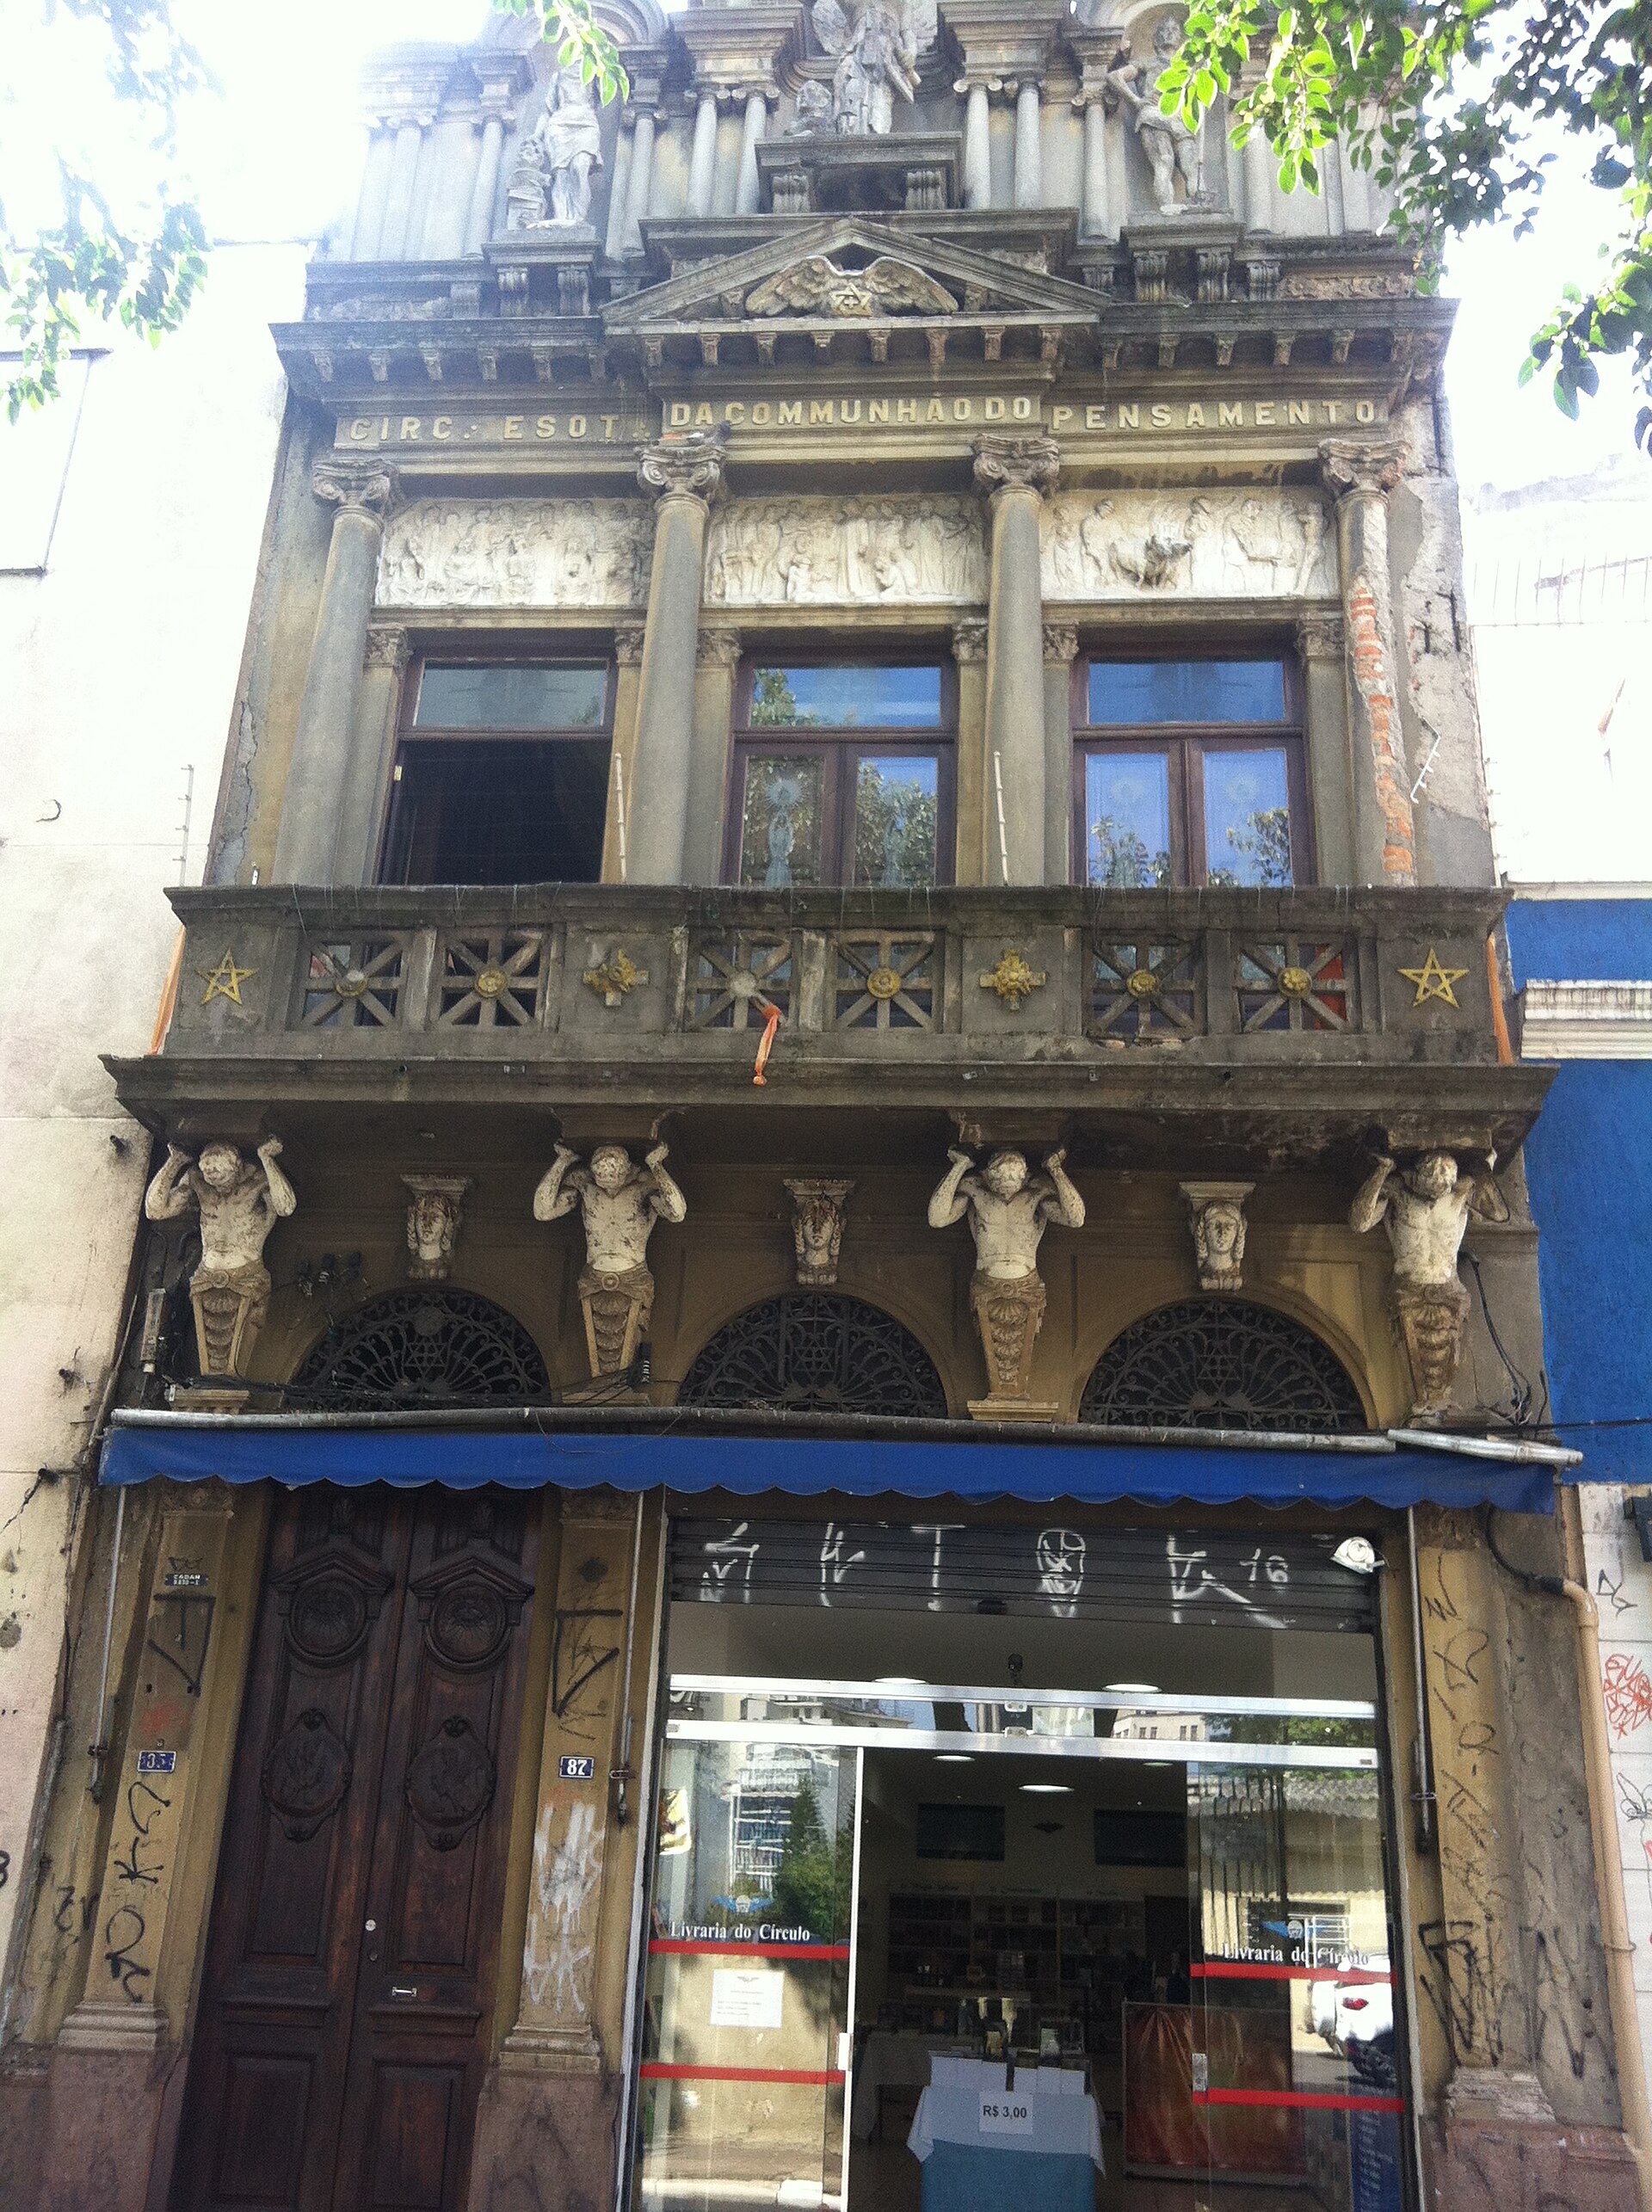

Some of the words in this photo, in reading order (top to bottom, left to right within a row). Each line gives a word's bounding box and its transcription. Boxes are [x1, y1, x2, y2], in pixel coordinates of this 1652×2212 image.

[670, 401, 714, 427] DA
[983, 396, 1031, 421] DO
[1052, 399, 1375, 430] PENSAMENTO
[566, 1759, 588, 1777] 87
[670, 1921, 727, 1939] Livraria
[734, 1923, 752, 1939] do
[983, 2104, 1000, 2118] R$
[1002, 2105, 1027, 2120] 3,00
